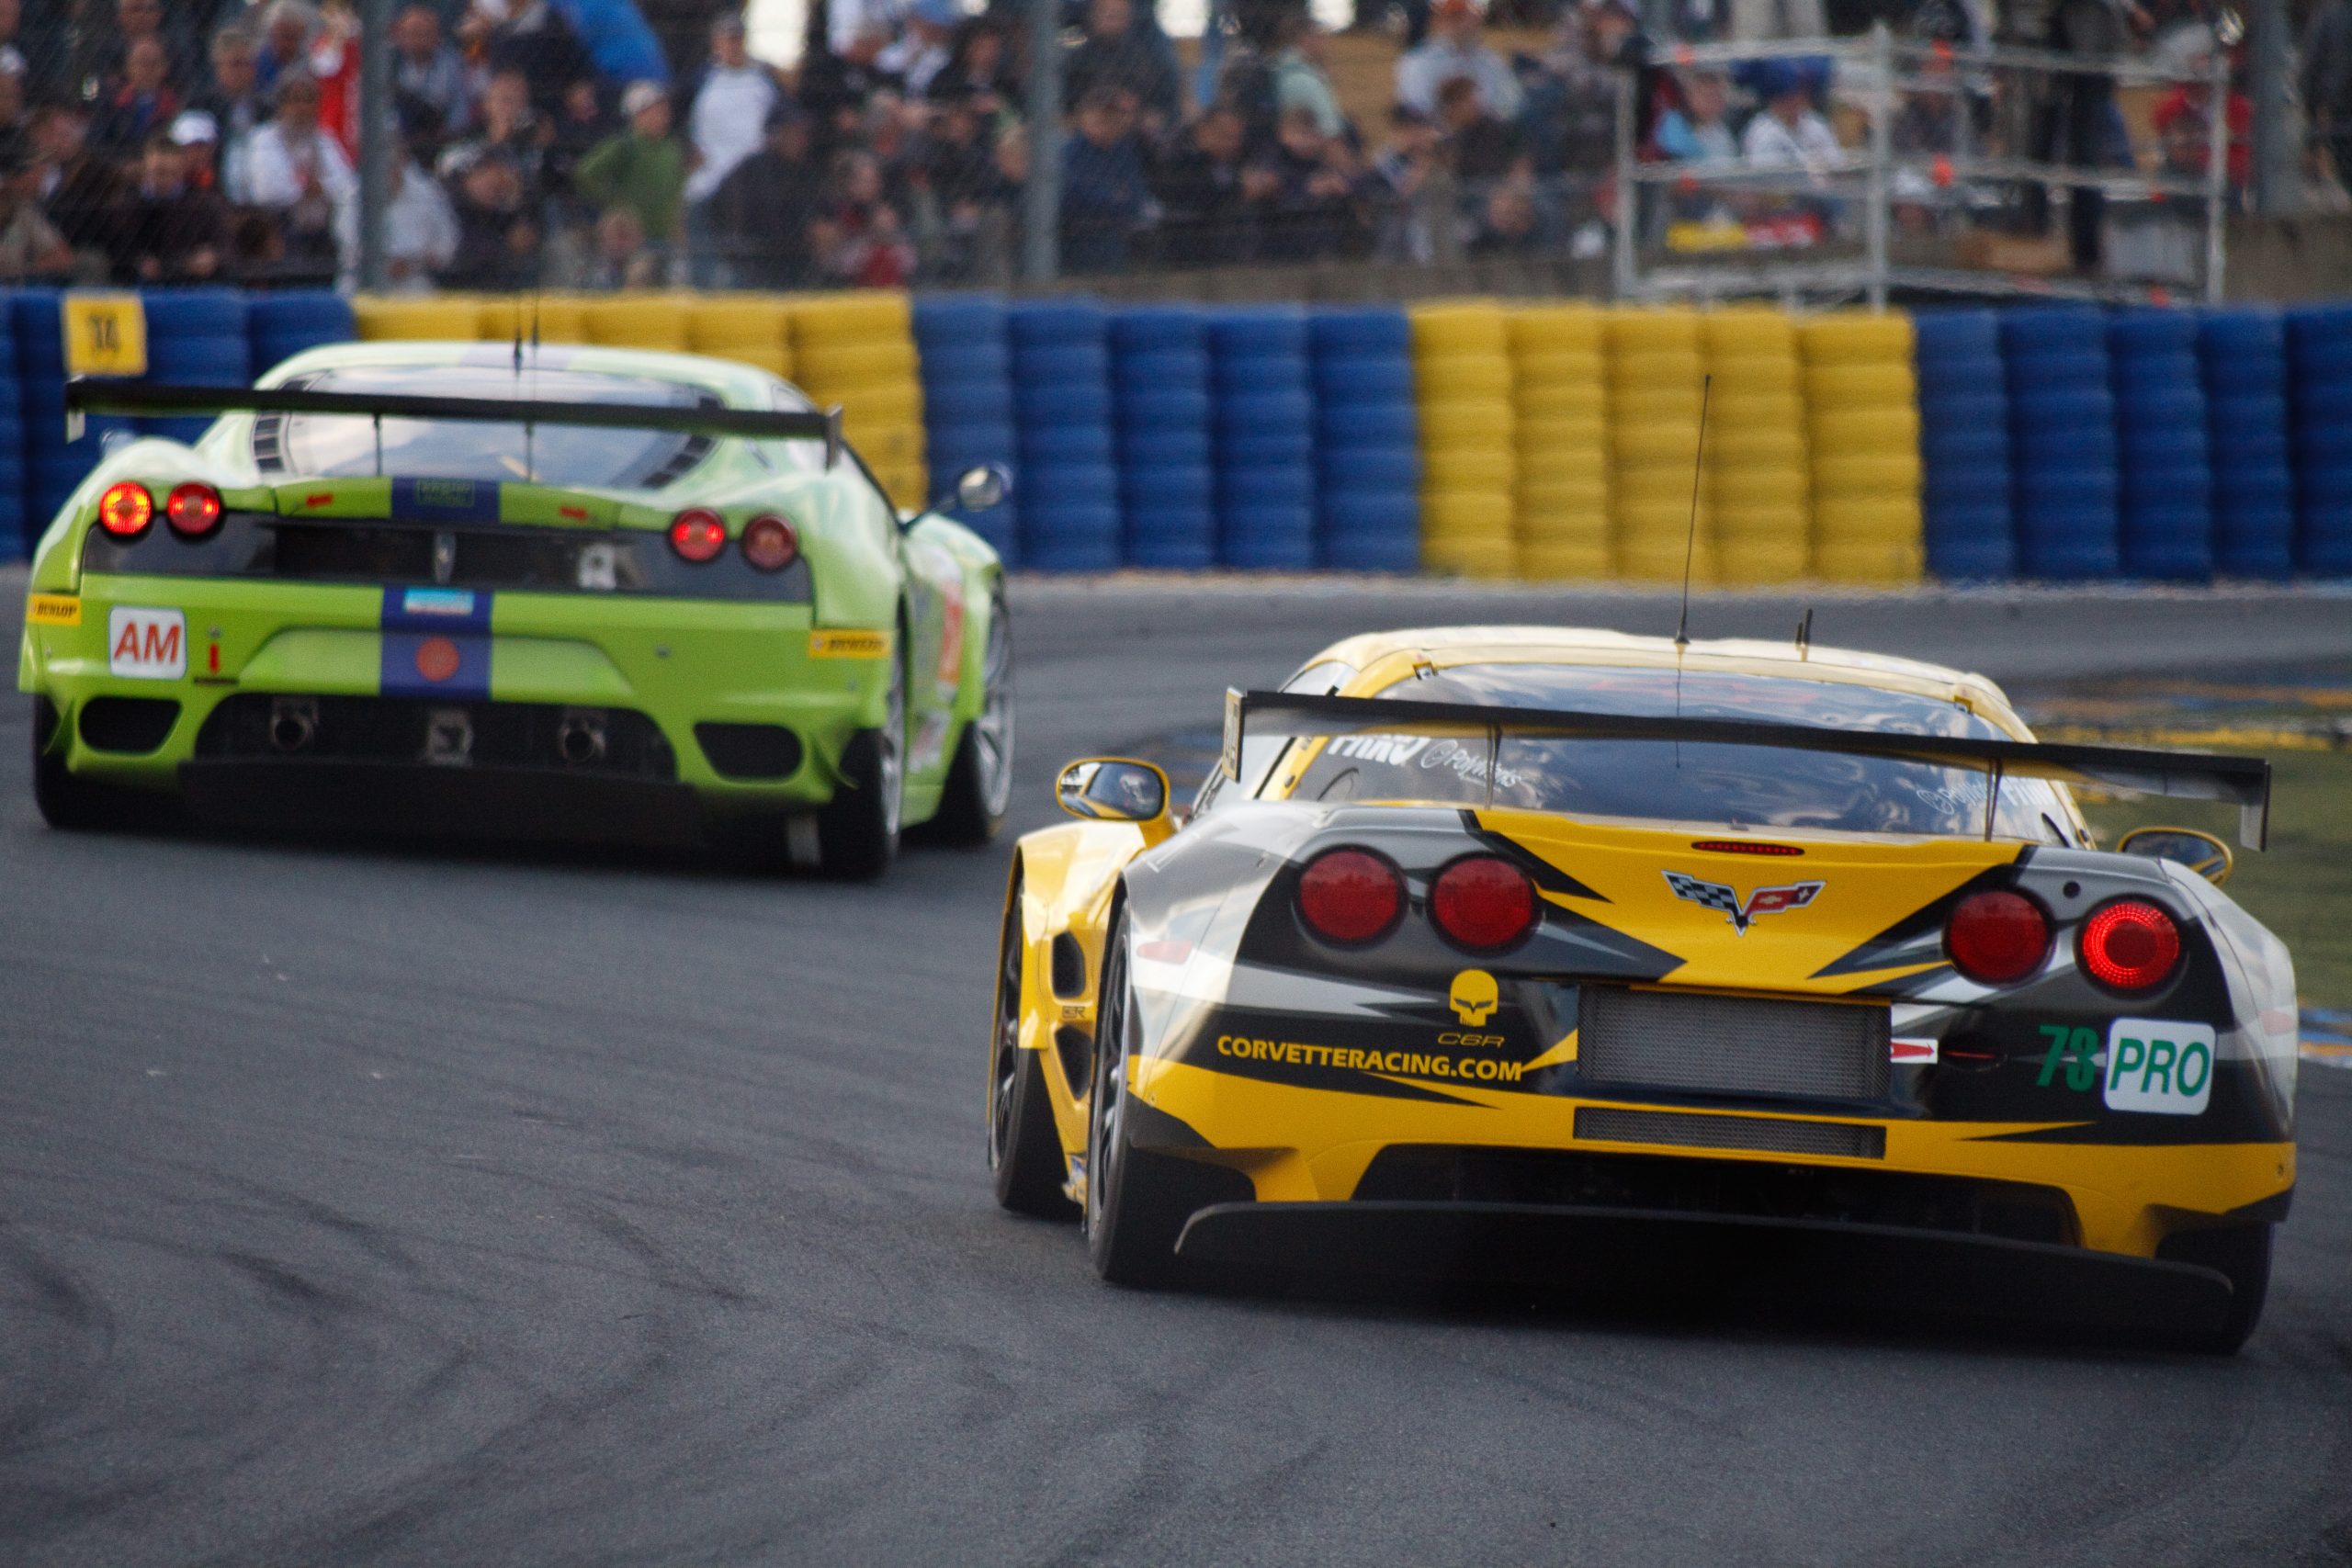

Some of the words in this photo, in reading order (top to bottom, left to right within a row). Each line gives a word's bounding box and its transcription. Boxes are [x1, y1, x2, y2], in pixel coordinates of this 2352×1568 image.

[37, 603, 77, 618] DUNLOP
[114, 620, 182, 664] AM
[1216, 1035, 1522, 1082] CORVETTERACING.COM
[1437, 1032, 1505, 1048] C6R
[2036, 1023, 2099, 1092] 73
[2109, 1037, 2211, 1097] PRO
